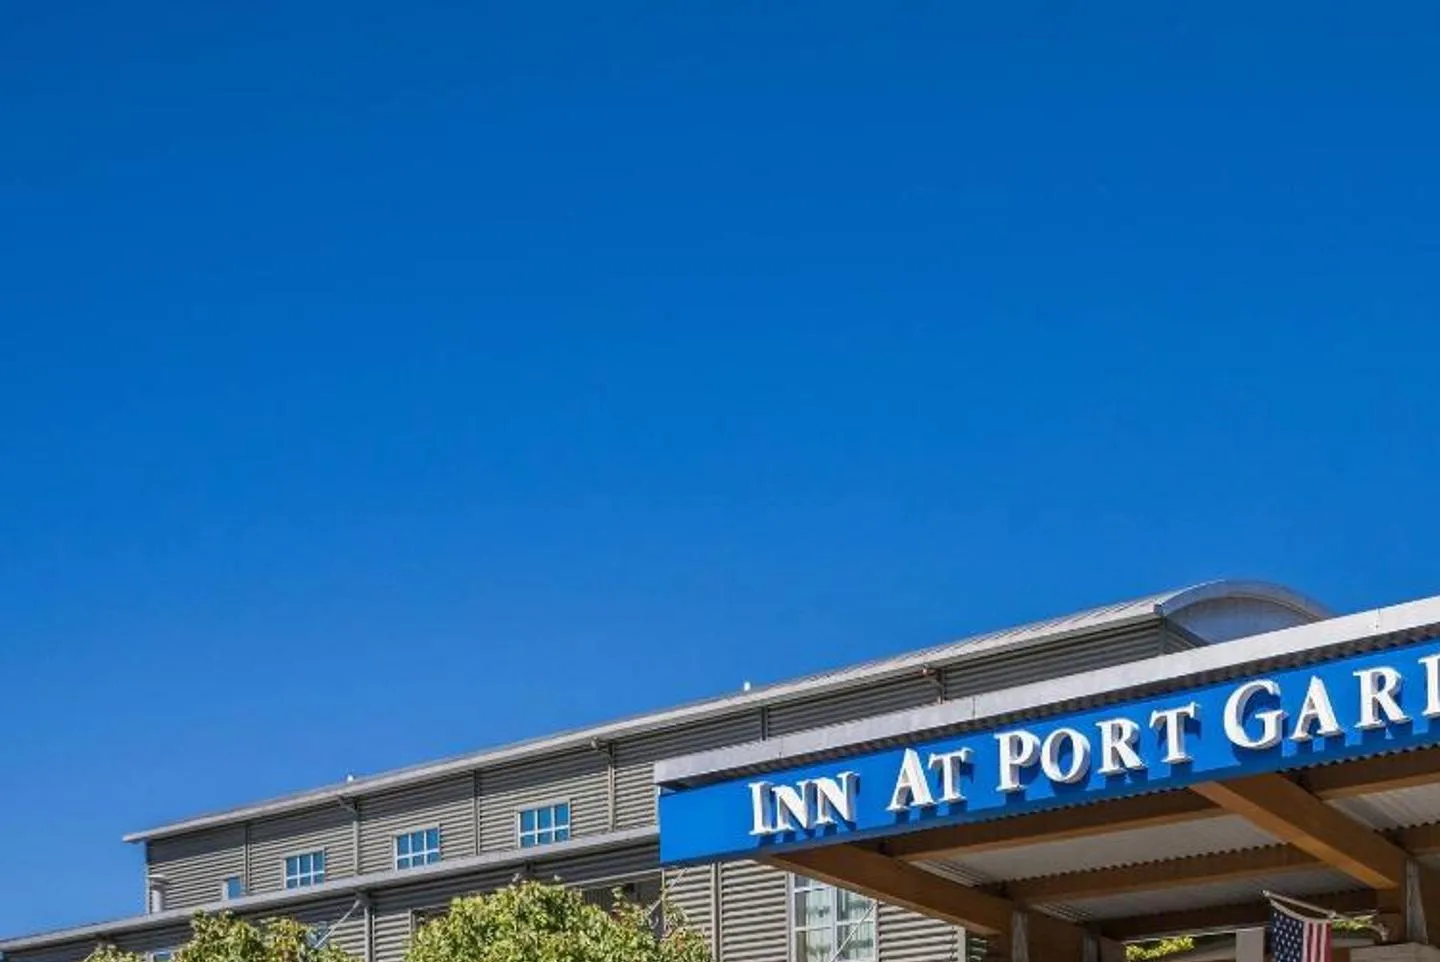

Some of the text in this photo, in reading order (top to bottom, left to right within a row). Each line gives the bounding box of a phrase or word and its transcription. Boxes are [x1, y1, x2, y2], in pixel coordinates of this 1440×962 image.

[747, 770, 860, 836] INN
[887, 747, 974, 812] AT
[994, 701, 1199, 792] PORT
